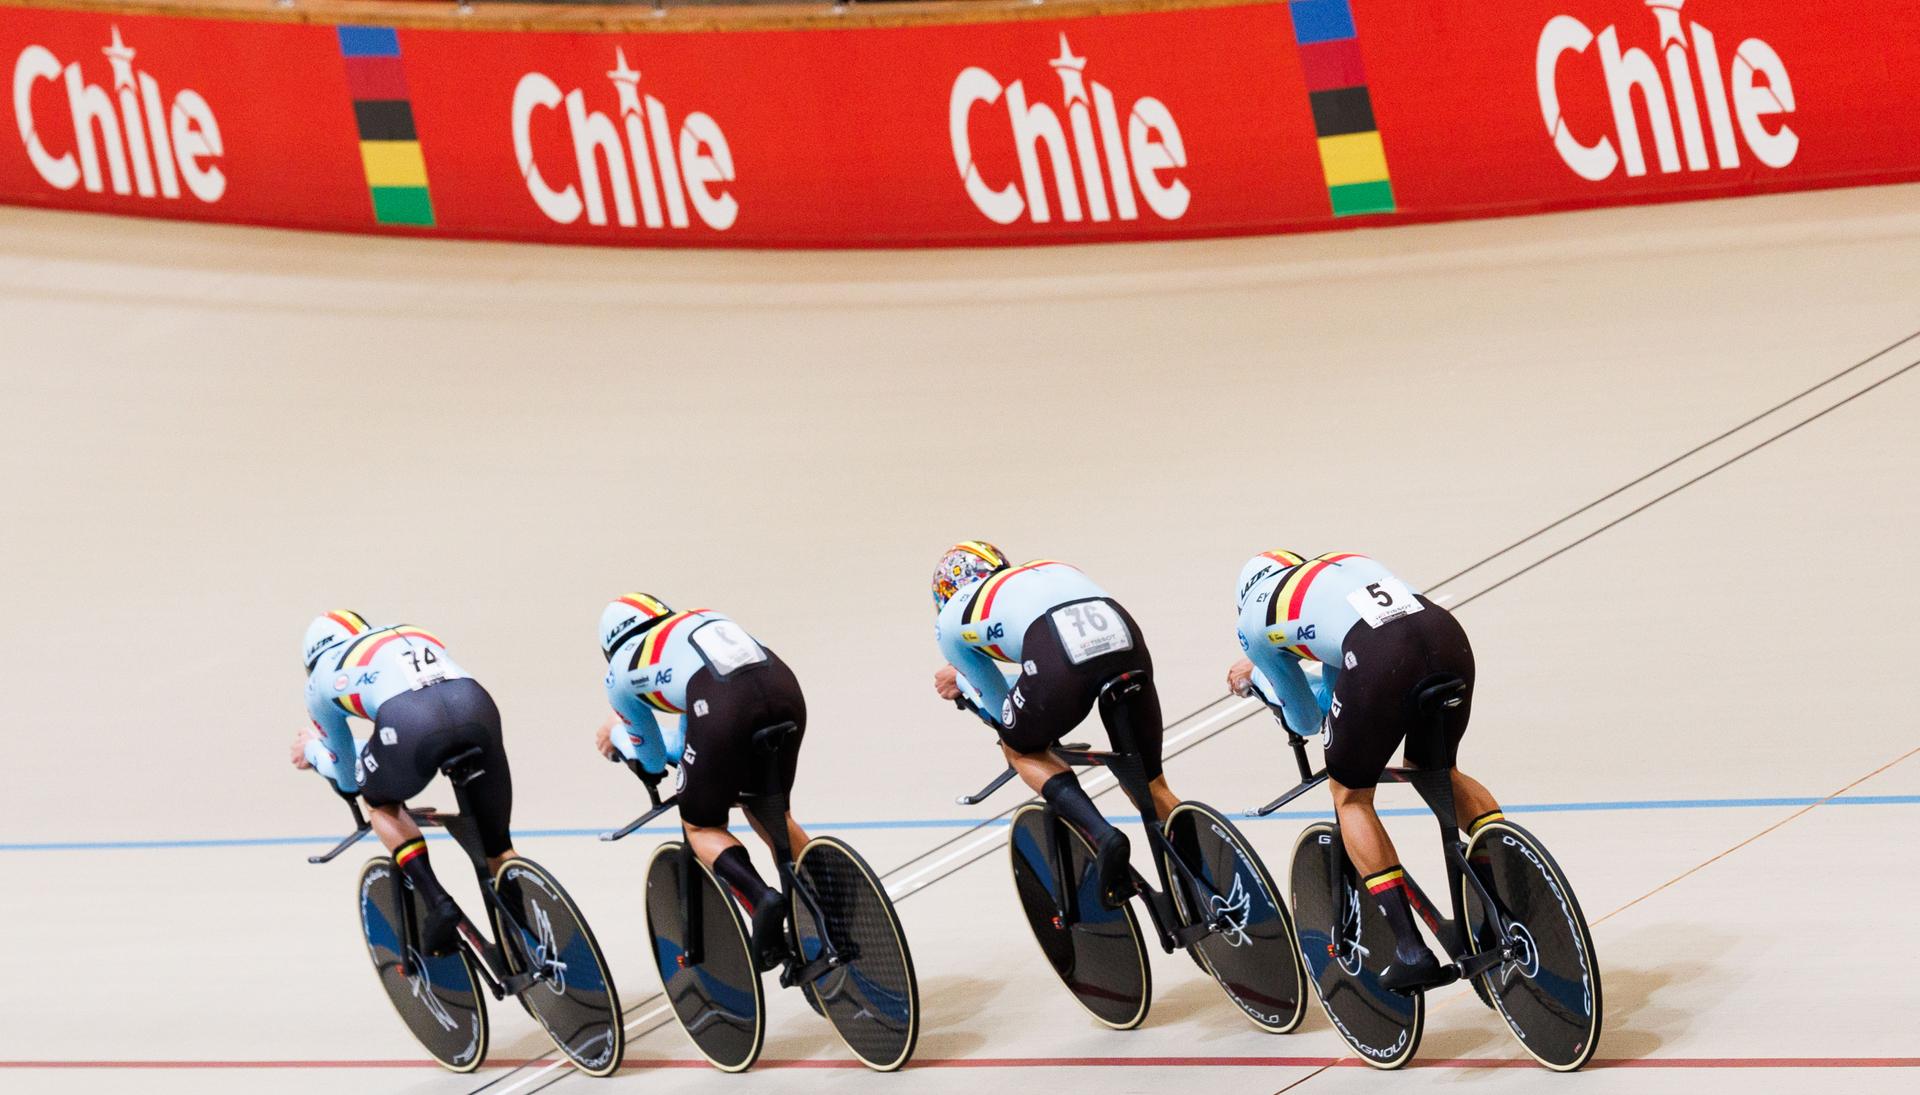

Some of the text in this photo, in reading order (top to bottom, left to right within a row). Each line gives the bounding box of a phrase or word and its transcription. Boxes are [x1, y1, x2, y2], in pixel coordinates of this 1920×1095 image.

[13, 26, 226, 203] Chile
[512, 48, 739, 230] Chile
[949, 34, 1191, 224] Chile
[1535, 0, 1799, 181] Chile
[1064, 605, 1108, 637] 76
[1241, 565, 1272, 600] LAZER
[1297, 624, 1316, 640] AG
[1366, 582, 1393, 607] 5
